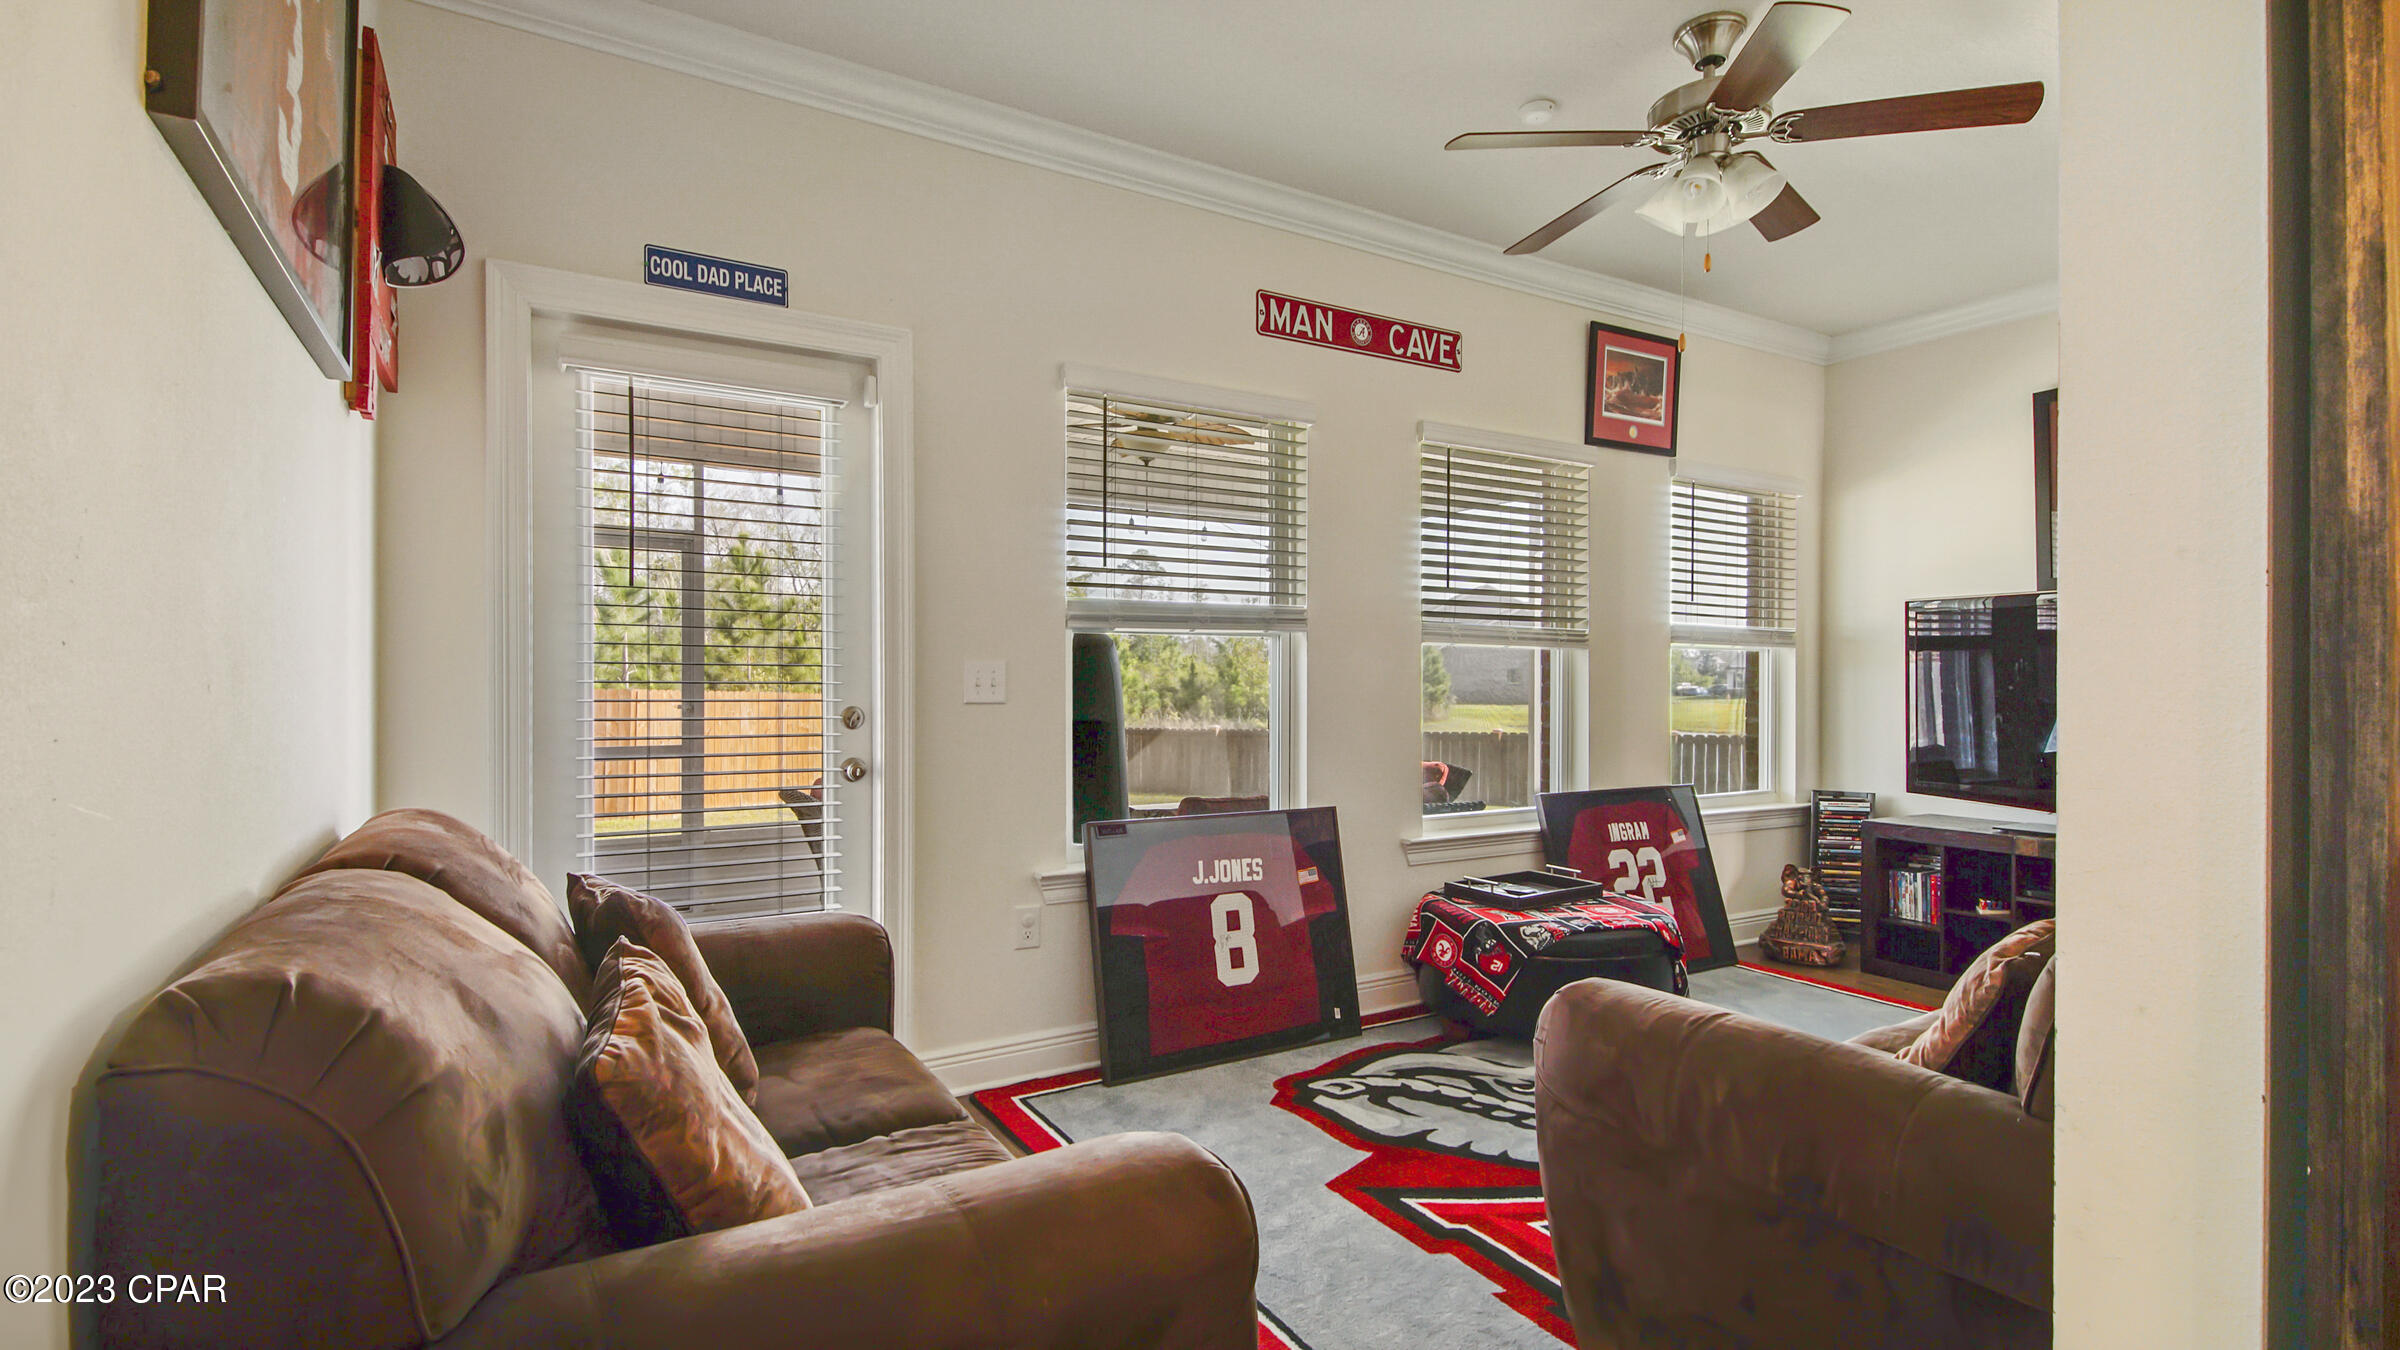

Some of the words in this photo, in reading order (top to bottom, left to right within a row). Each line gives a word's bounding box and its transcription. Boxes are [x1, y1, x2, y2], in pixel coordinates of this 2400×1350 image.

[650, 255, 693, 281] COOL
[697, 264, 730, 287] DAD
[734, 271, 783, 297] PLACE
[1269, 298, 1333, 342] MAN
[1388, 324, 1454, 365] CAVE
[1607, 821, 1650, 843] INGRAM
[1192, 857, 1263, 885] J.JONES
[1607, 846, 1675, 915] 22
[1210, 891, 1260, 987] 8
